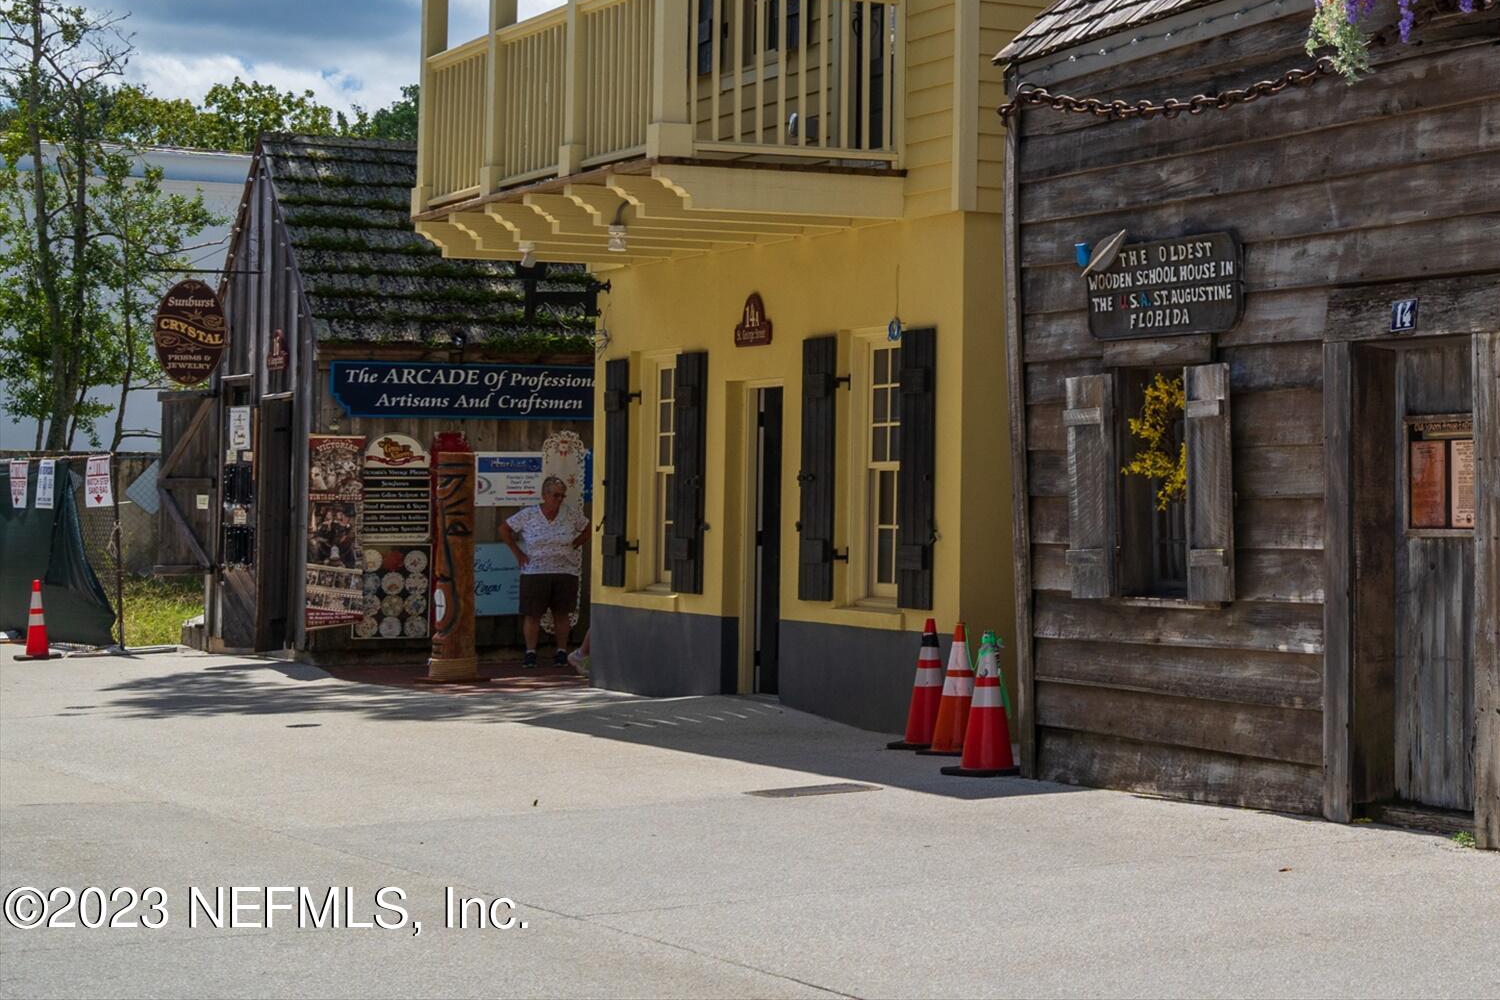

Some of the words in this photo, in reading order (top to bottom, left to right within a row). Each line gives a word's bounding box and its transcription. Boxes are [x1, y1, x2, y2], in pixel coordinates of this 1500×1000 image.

[1119, 250, 1147, 267] THE
[1159, 242, 1212, 262] OLDEST
[1088, 272, 1132, 291] WOODEN
[1136, 266, 1177, 286] SCHOOL
[1180, 263, 1216, 281] HOUSE
[1220, 261, 1233, 276] IN
[167, 296, 215, 307] Sunburst
[1092, 296, 1113, 312] THE
[1129, 308, 1190, 329] FLORIDA
[1395, 301, 1412, 328] 14
[160, 319, 223, 344] CRYSTAL
[166, 362, 212, 370] JEWELRY
[345, 368, 378, 384] The
[382, 368, 479, 385] ARCADE
[375, 393, 449, 408] Artisans
[453, 391, 494, 408] And
[498, 392, 583, 414] Craftsmen
